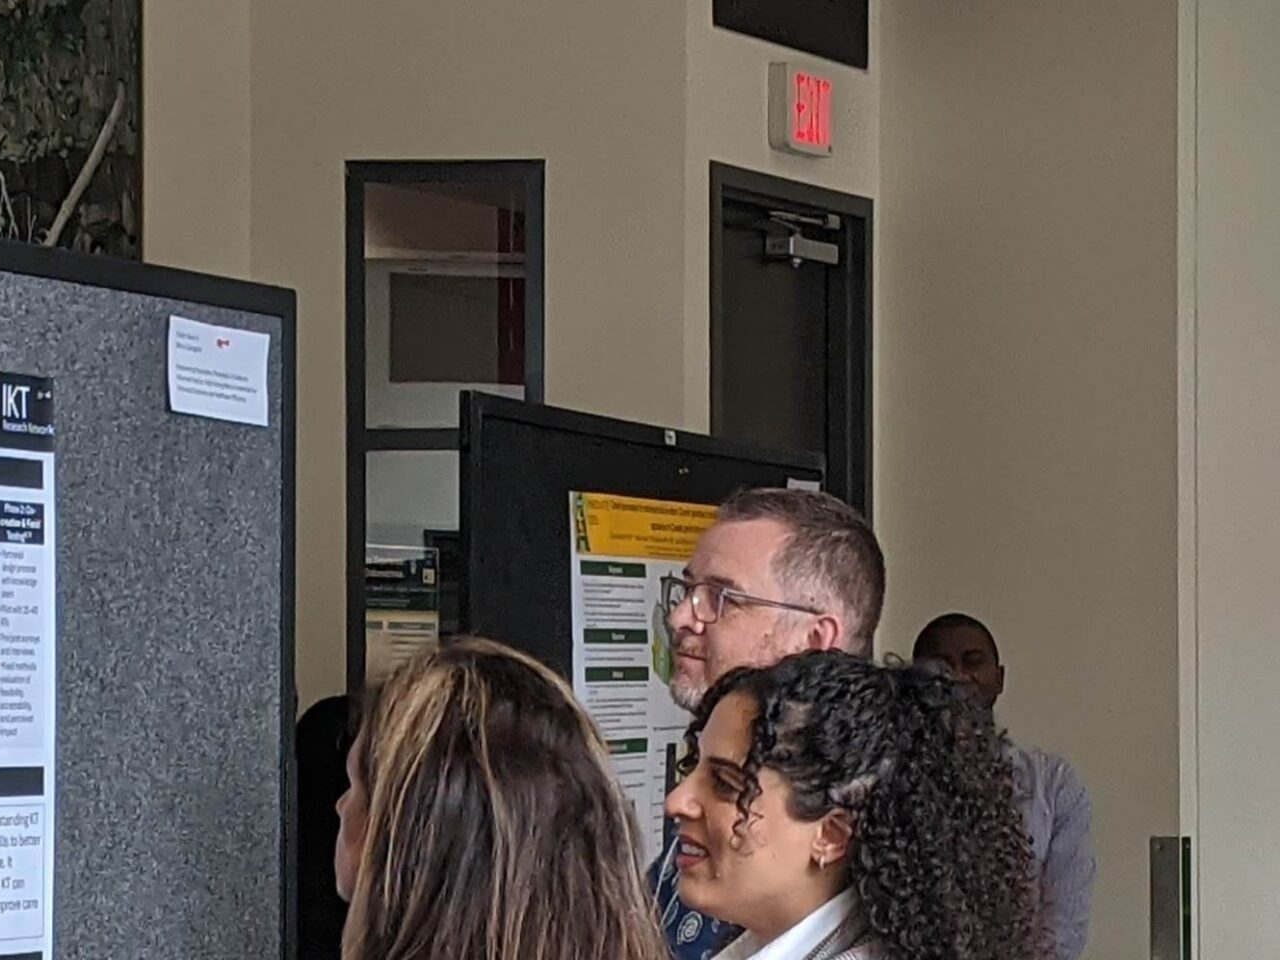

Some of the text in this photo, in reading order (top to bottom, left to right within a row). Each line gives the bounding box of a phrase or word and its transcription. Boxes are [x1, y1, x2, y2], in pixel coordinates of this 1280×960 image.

[796, 73, 830, 146] EXIT
[2, 383, 30, 419] IKT
[29, 812, 39, 825] KT
[10, 835, 18, 847] to
[19, 835, 41, 847] better
[1, 876, 11, 889] KT
[12, 878, 25, 889] can
[22, 899, 38, 911] care
